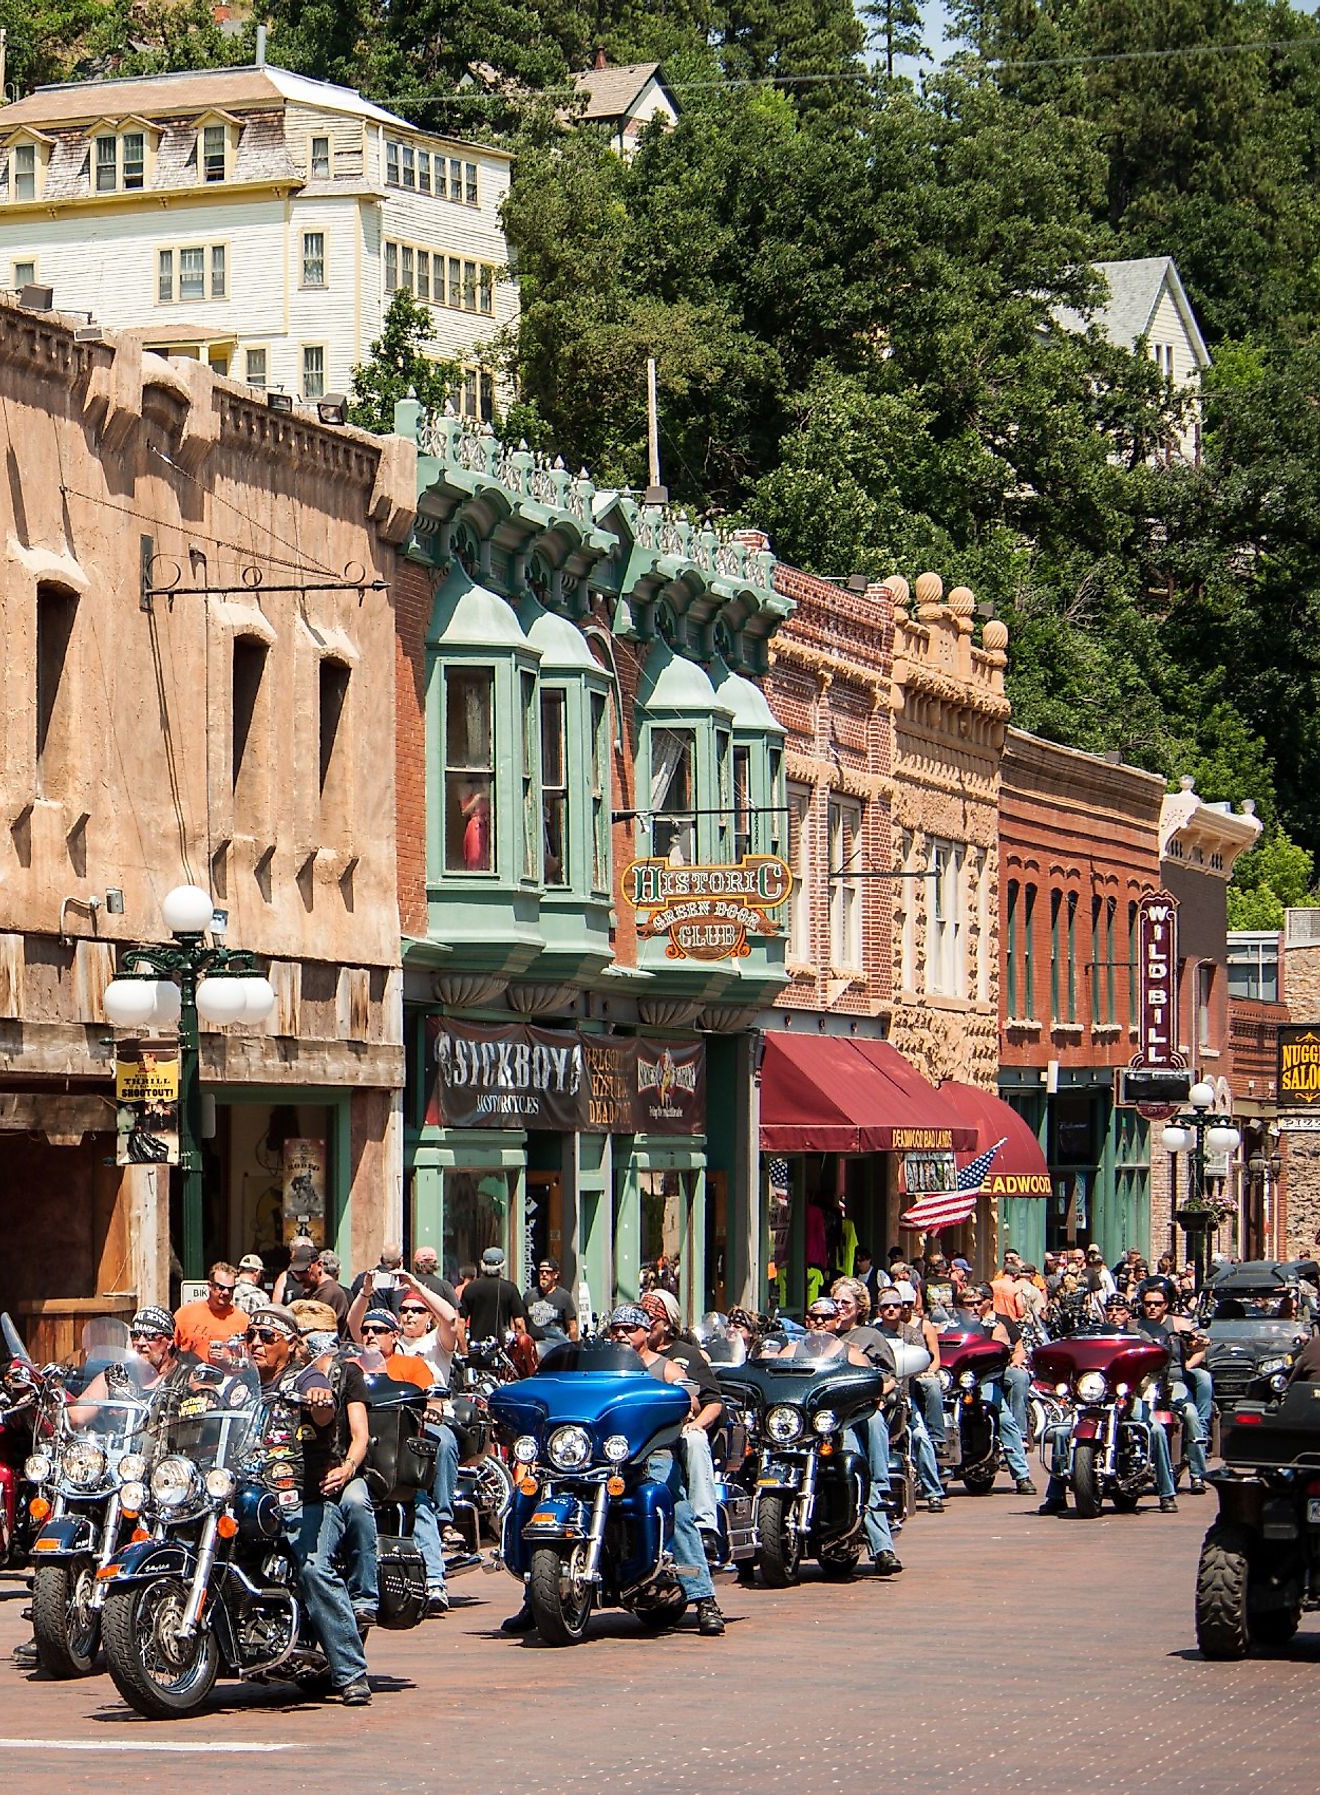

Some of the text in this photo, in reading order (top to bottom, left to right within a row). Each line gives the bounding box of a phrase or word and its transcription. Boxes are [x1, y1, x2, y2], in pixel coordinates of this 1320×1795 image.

[632, 862, 782, 904] HISTORIC
[653, 900, 761, 932] GREEN DOOR
[679, 924, 737, 948] CLUB
[1147, 906, 1169, 979] WILD
[1147, 989, 1168, 1063] BILL
[1282, 1045, 1320, 1071] NUGG
[121, 1088, 173, 1098] SHOOTOUT!
[981, 1176, 1051, 1194] EADWOOD
[193, 1288, 208, 1298] BIK
